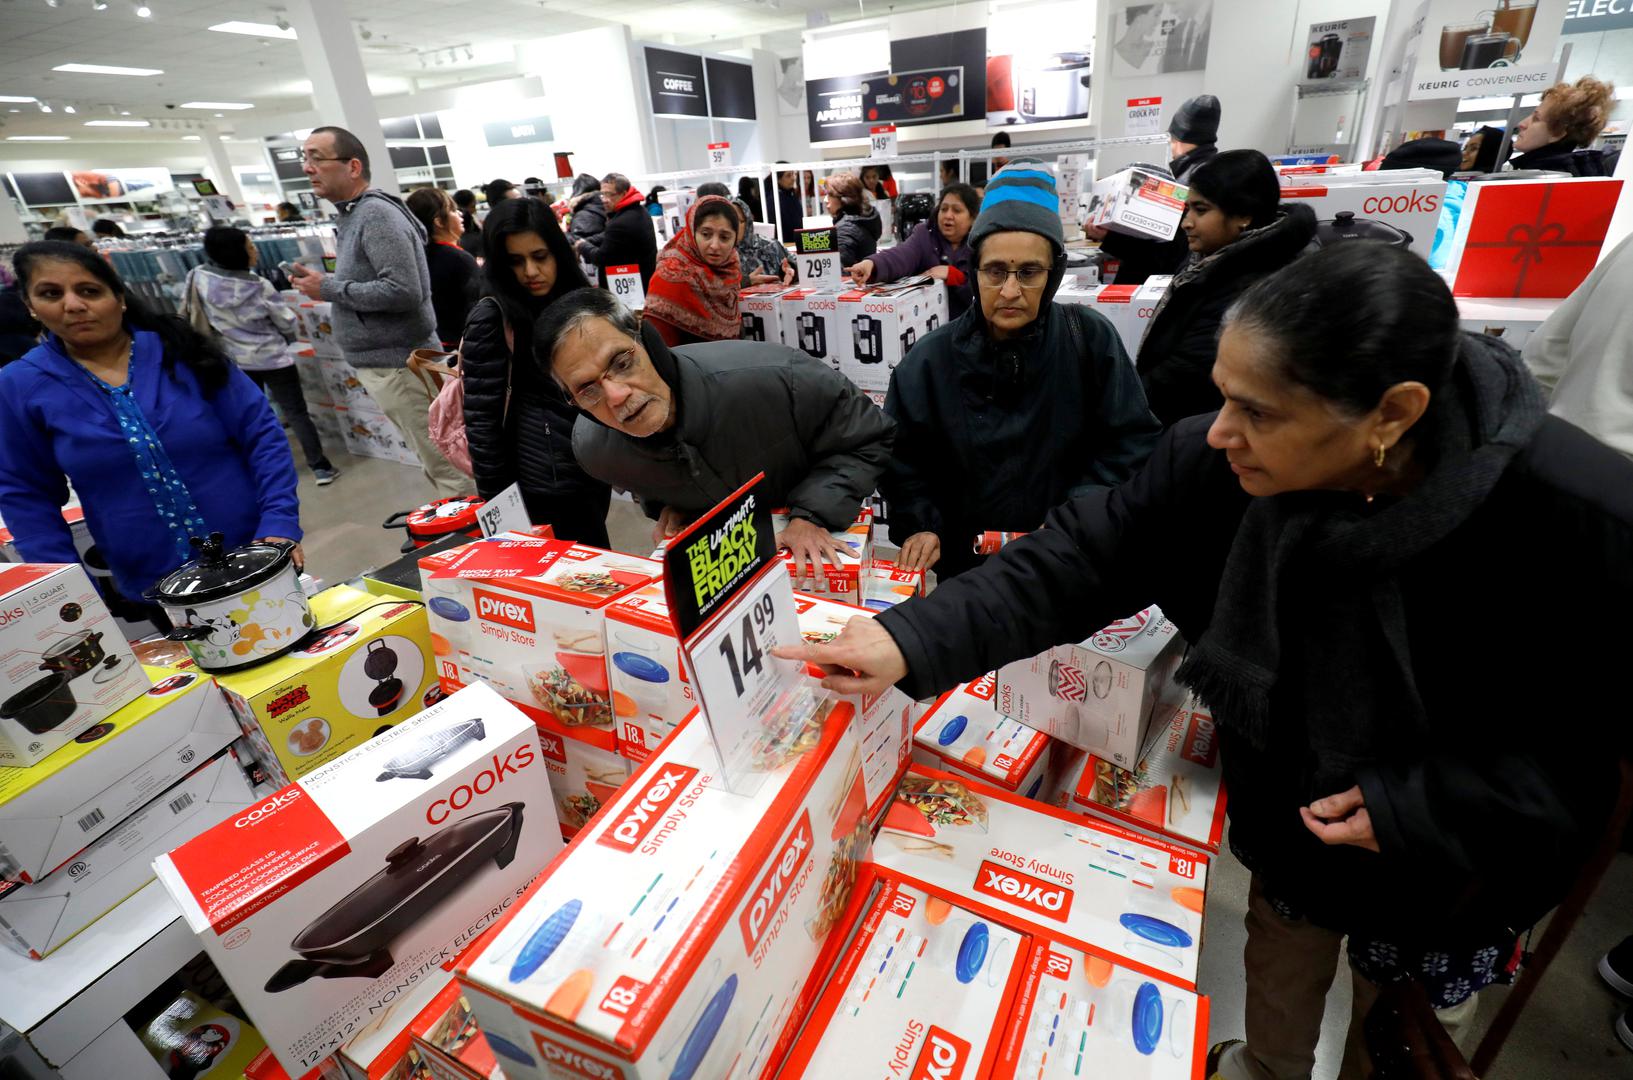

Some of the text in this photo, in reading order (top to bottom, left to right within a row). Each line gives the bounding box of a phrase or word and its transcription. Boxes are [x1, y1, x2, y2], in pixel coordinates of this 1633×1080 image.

[1312, 22, 1349, 33] KEURIG
[1564, 0, 1633, 19] ELEC
[663, 78, 693, 92] COFFEE
[1418, 72, 1548, 91] KEURIG CONVENIENCE
[816, 107, 862, 122] APPLIAN
[1128, 107, 1160, 119] CROCK POT
[1363, 189, 1439, 214] cooks
[1123, 213, 1171, 234] BLACK+DECKER
[803, 242, 829, 250] FRIDAY
[747, 301, 773, 311] cooks
[808, 299, 836, 311] cooks
[864, 303, 894, 313] cooks
[686, 494, 756, 560] THE ULTIMATE
[690, 512, 757, 585] BLACK
[39, 583, 66, 600] QUART
[694, 535, 758, 609] FRIDAY
[699, 599, 715, 615] DEALS
[713, 588, 724, 602] THAT
[723, 581, 733, 593] LIVE
[743, 565, 752, 575] THE
[0, 606, 25, 626] oks
[478, 596, 531, 625] pyrex
[480, 622, 536, 647] Simply Store
[1002, 684, 1012, 714] cooks
[304, 751, 364, 785] NONSTICK
[365, 725, 409, 752] ELECTRIC
[411, 704, 446, 727] SKILLET
[1167, 709, 1188, 753] Simply Store
[1189, 716, 1209, 762] pyrex
[425, 743, 535, 826] cooks
[234, 788, 300, 829] cooks
[612, 768, 688, 846] pyrex
[641, 774, 713, 856] Simply Store
[200, 849, 277, 897] TEMPERED GLASS LID
[204, 849, 292, 904] COOL TOUCH HANDLES
[207, 840, 320, 914] NONSTICK COOKING SURFACE
[266, 862, 301, 886] CONTROL
[301, 850, 319, 865] DIAL
[749, 825, 810, 944] pyrex
[989, 846, 1075, 886] Simply Store
[219, 883, 289, 929] MULTI-FUNCTIONAL
[983, 868, 1067, 911] pyrex
[752, 857, 815, 969] Simply Store
[368, 946, 450, 1015] NONSTICK
[454, 896, 513, 948] ELECTRIC
[888, 1019, 924, 1077] Simply
